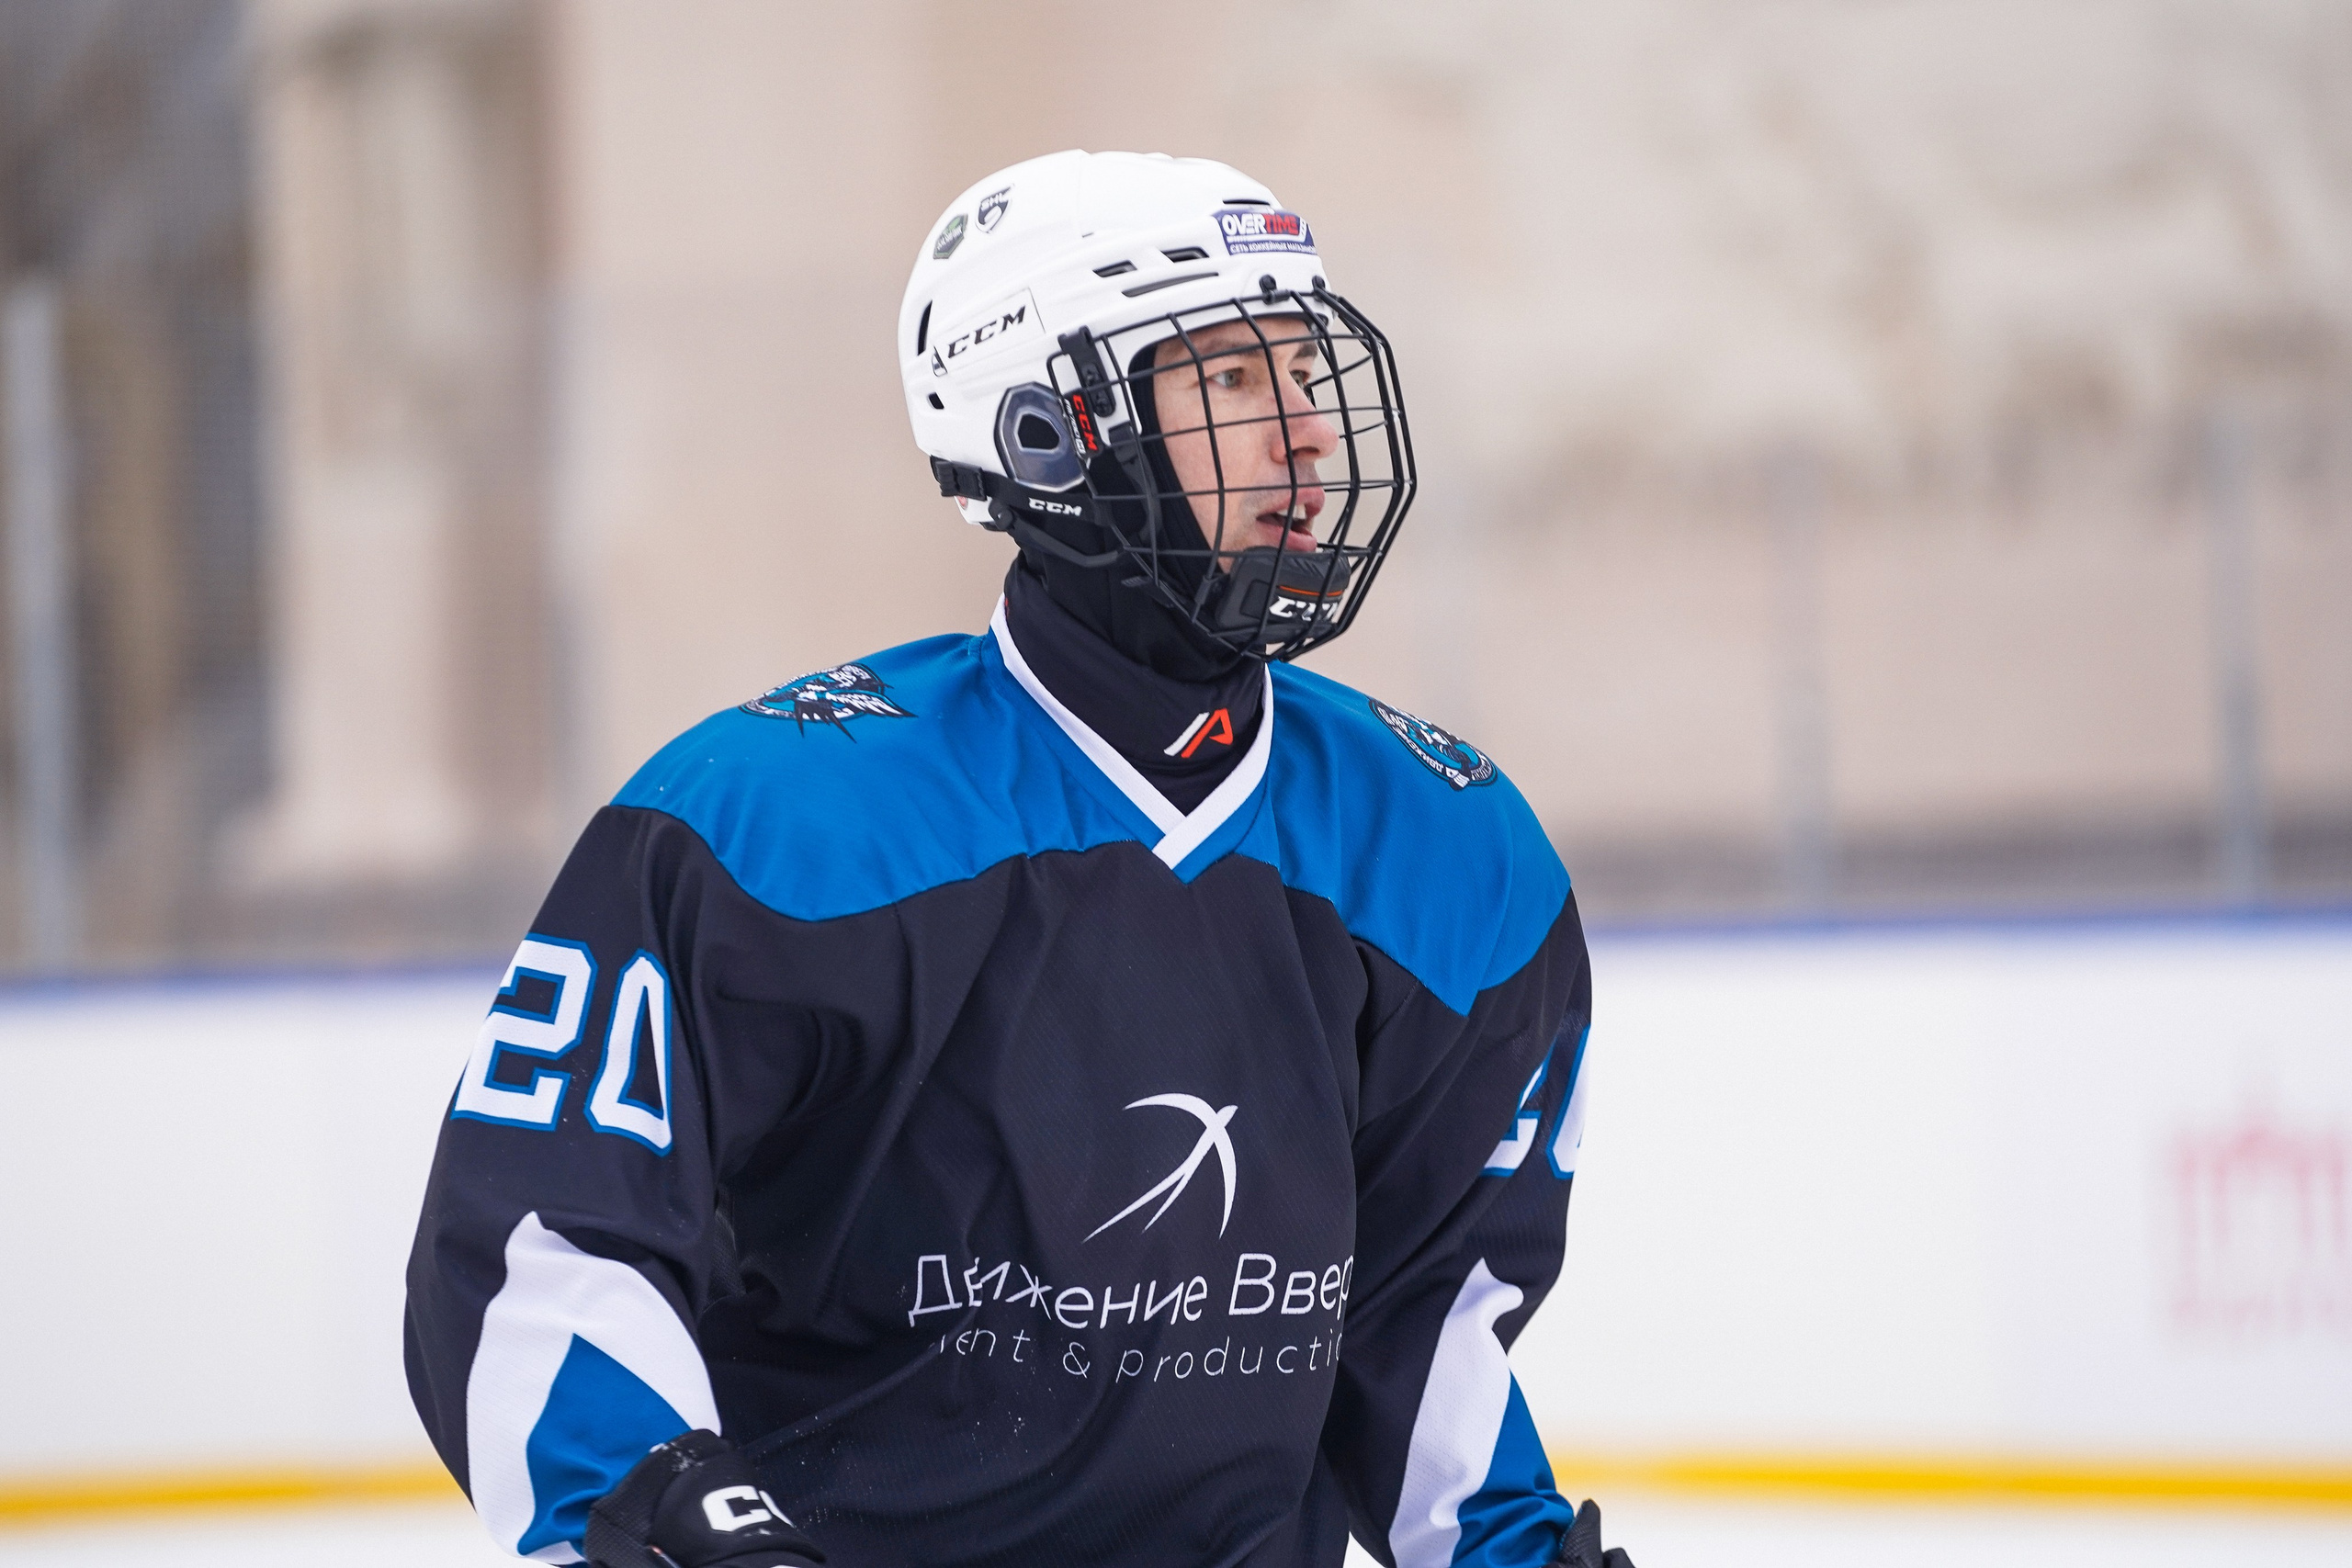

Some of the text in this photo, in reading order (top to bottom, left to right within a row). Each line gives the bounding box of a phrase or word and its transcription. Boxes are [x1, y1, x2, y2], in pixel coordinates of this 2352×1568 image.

[1221, 212, 1300, 236] OVERTIME
[948, 305, 1026, 359] CCM
[1072, 394, 1099, 452] CCM
[1028, 497, 1083, 517] CCM
[450, 931, 673, 1157] 20
[1228, 1252, 1354, 1321] Ввер
[1062, 1341, 1091, 1379] &
